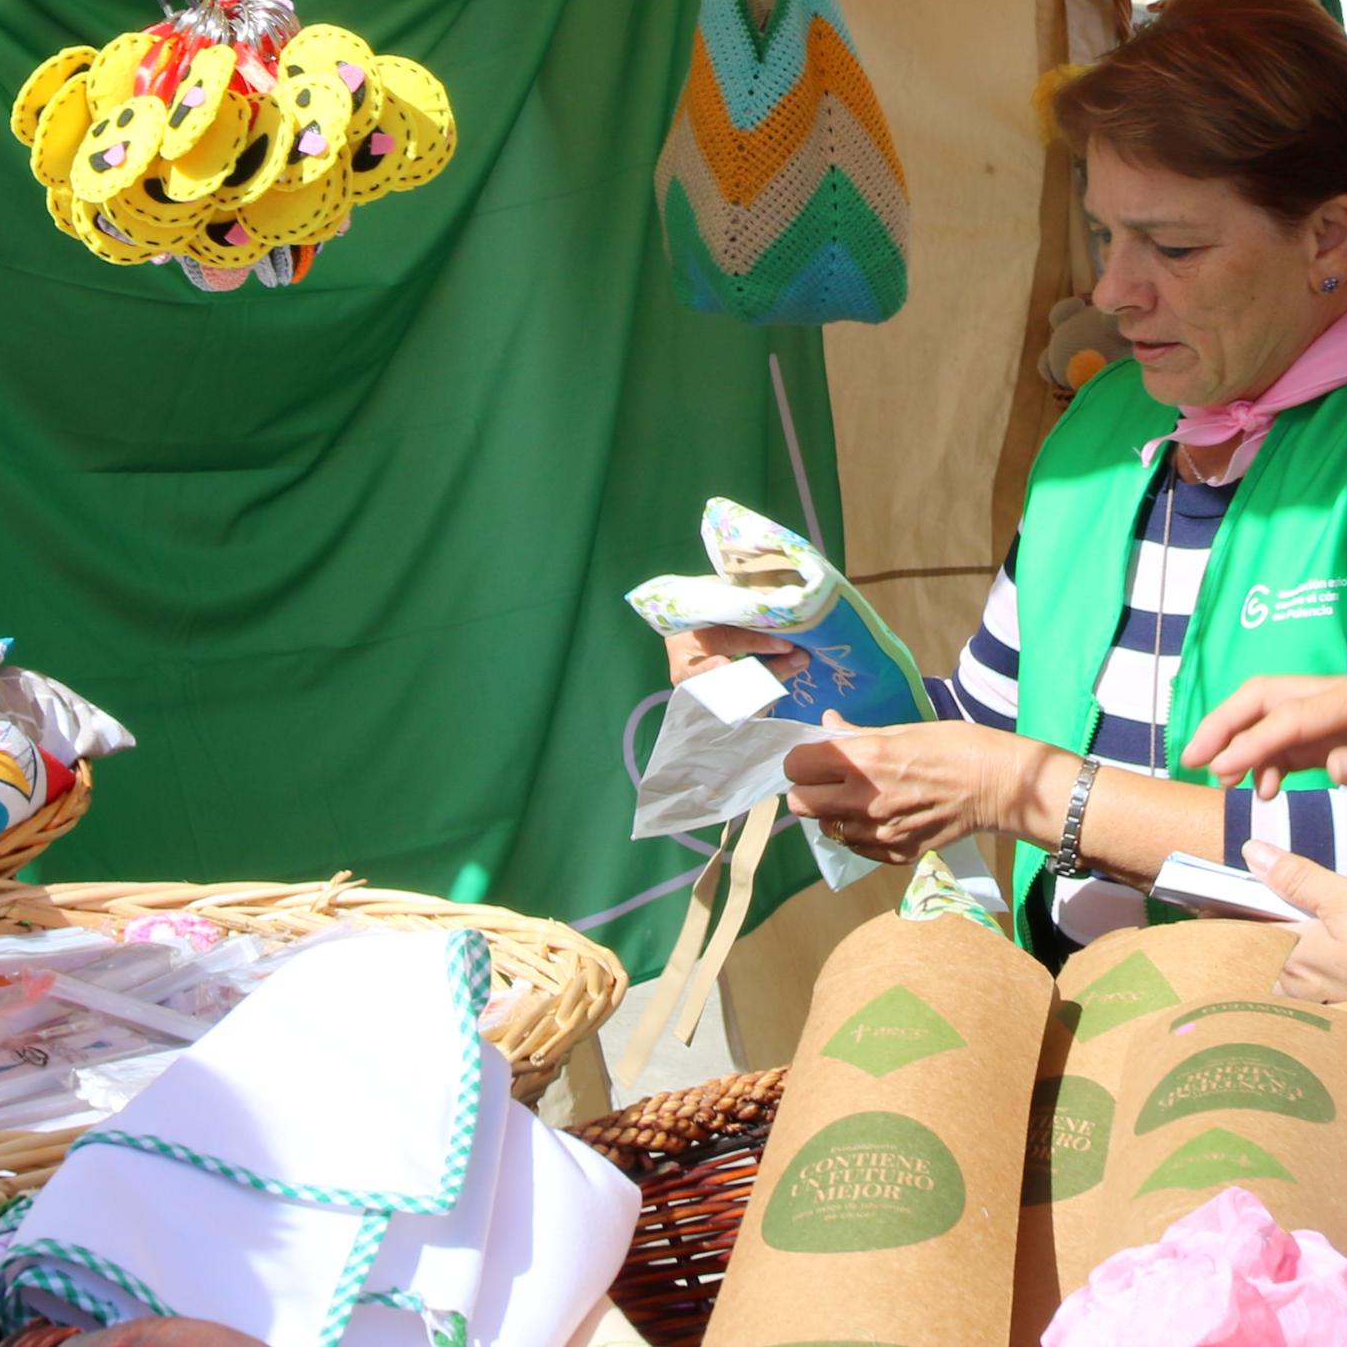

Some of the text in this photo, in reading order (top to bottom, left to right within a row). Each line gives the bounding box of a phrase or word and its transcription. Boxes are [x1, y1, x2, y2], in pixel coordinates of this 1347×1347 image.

[1287, 604, 1334, 619] Palencia
[800, 1152, 931, 1180] CONTIENE
[791, 1167, 936, 1198] UN FUTURO
[816, 1183, 904, 1203] MEJOR
